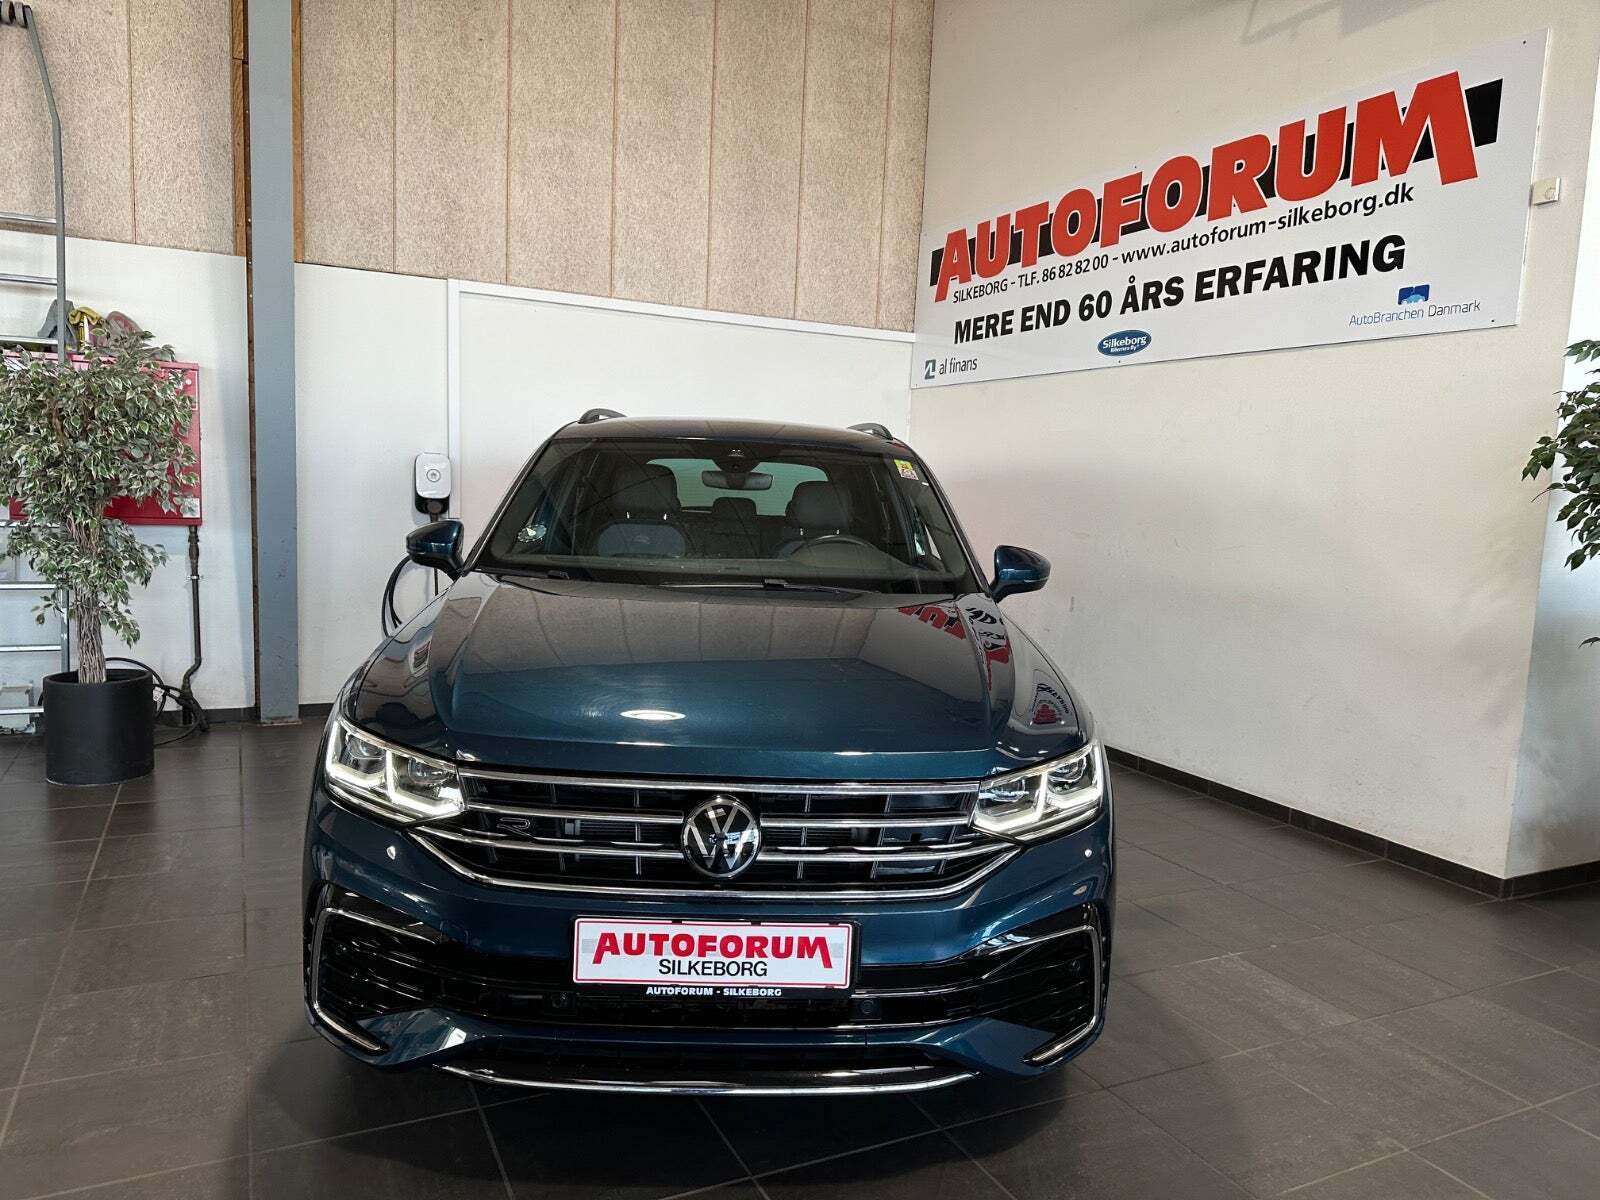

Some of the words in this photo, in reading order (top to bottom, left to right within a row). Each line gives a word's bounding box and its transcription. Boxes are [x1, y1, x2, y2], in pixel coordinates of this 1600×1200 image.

[935, 70, 1478, 302] AUTOFORUM
[953, 278, 1008, 303] SILKEBORG
[1018, 271, 1040, 288] TLF.
[1121, 182, 1415, 264] www.autoforum-silkeborg.dk
[954, 309, 1015, 345] MERE
[1020, 299, 1071, 338] END
[1078, 290, 1113, 322] 60
[1120, 275, 1185, 315] ÅRS
[1194, 234, 1406, 302] ERFARING
[1349, 307, 1424, 326] AutoBranchen
[1428, 299, 1481, 317] Danmark
[1102, 336, 1147, 349] Silkeborg
[939, 359, 948, 375] al
[949, 356, 978, 374] finans
[592, 932, 833, 969] AUTOFORUM
[658, 959, 768, 977] SILKEBORG
[646, 986, 713, 996] AUTOFORUM
[723, 987, 782, 997] SILKEBORG
